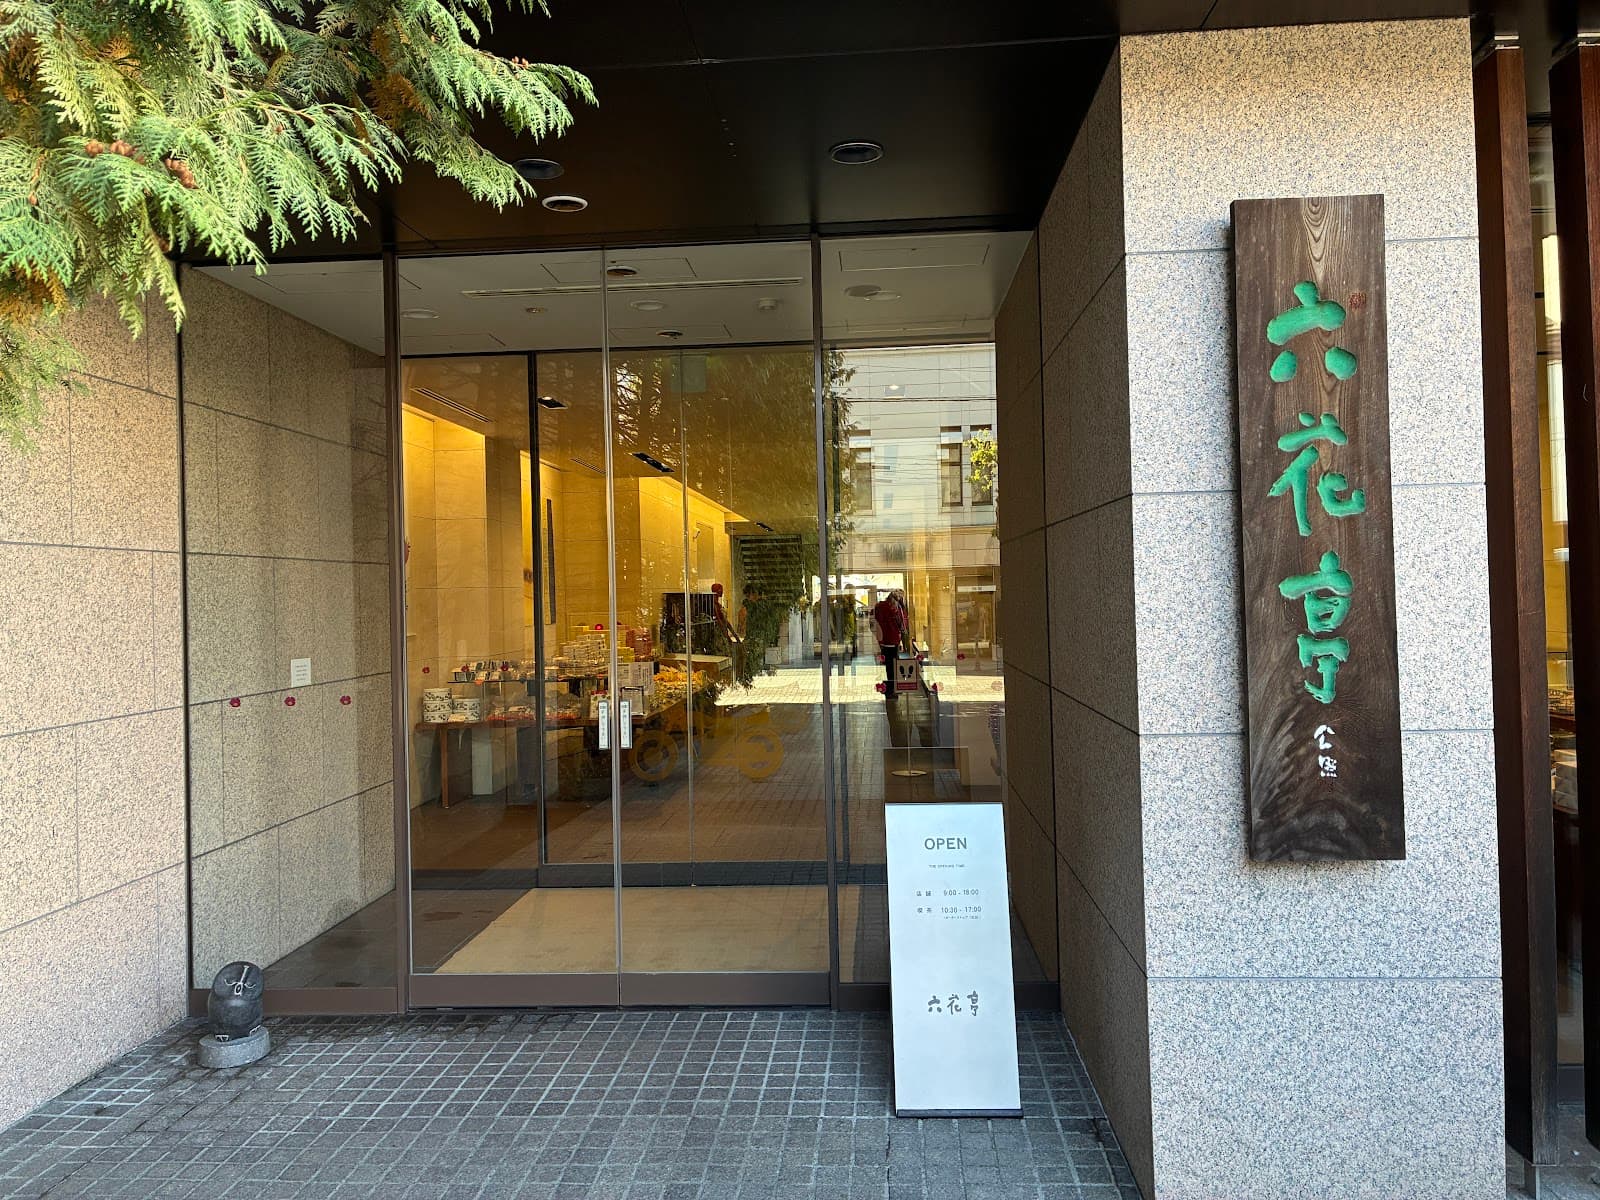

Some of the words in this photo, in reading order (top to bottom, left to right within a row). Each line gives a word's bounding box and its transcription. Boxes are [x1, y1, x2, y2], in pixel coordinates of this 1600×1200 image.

[1267, 281, 1366, 704] 六花亭
[924, 837, 968, 850] OPEN
[927, 990, 979, 1016] 六花亭
